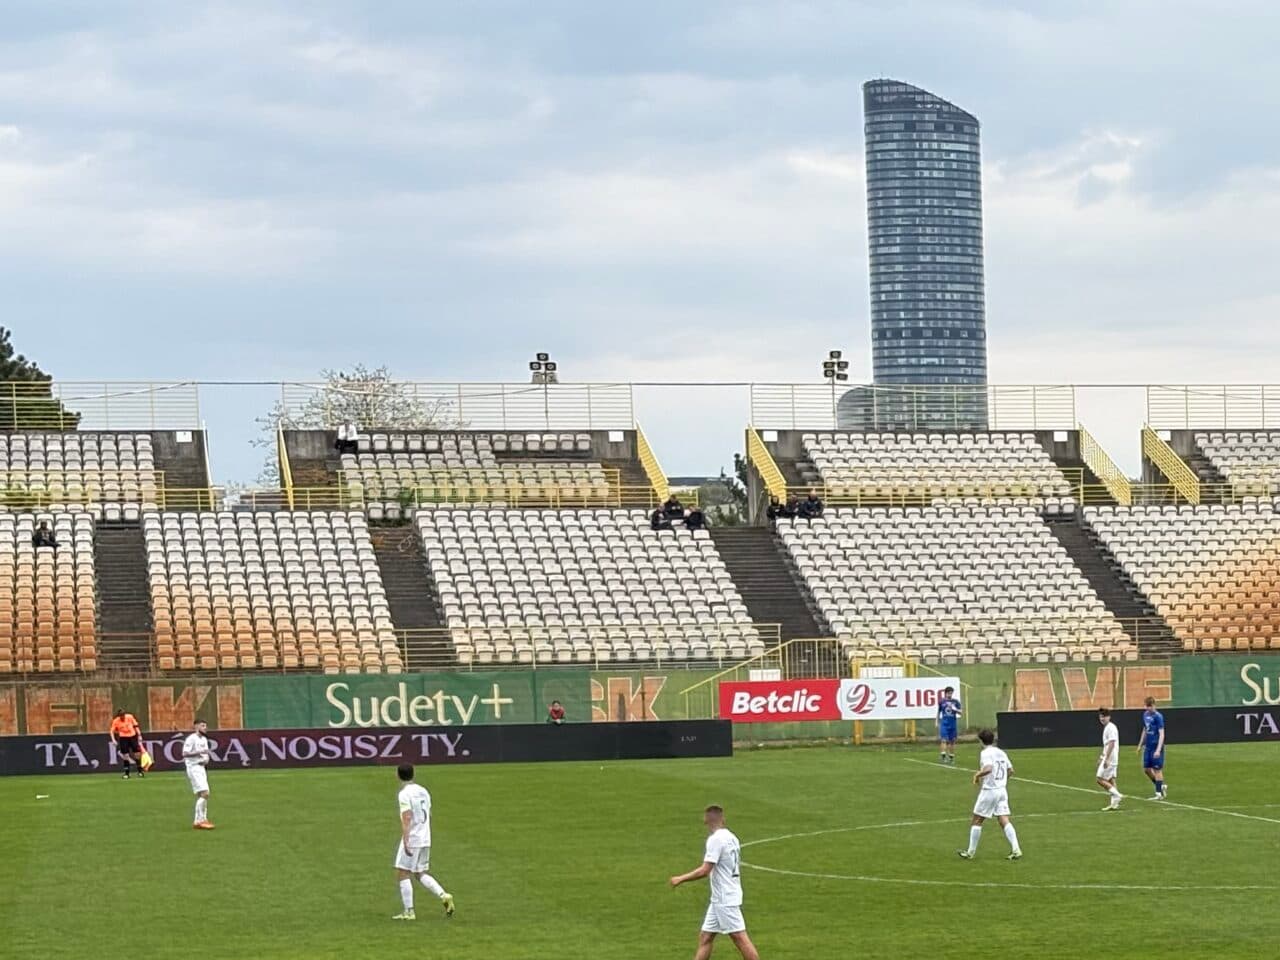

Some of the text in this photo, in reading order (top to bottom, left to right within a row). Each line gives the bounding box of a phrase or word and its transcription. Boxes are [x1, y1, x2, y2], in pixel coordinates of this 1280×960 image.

[326, 682, 514, 728] Sudety+
[731, 688, 822, 714] Betclic
[886, 689, 898, 707] 2
[35, 741, 100, 768] TA,
[261, 732, 403, 761] NOSISZ
[412, 732, 470, 757] TY.
